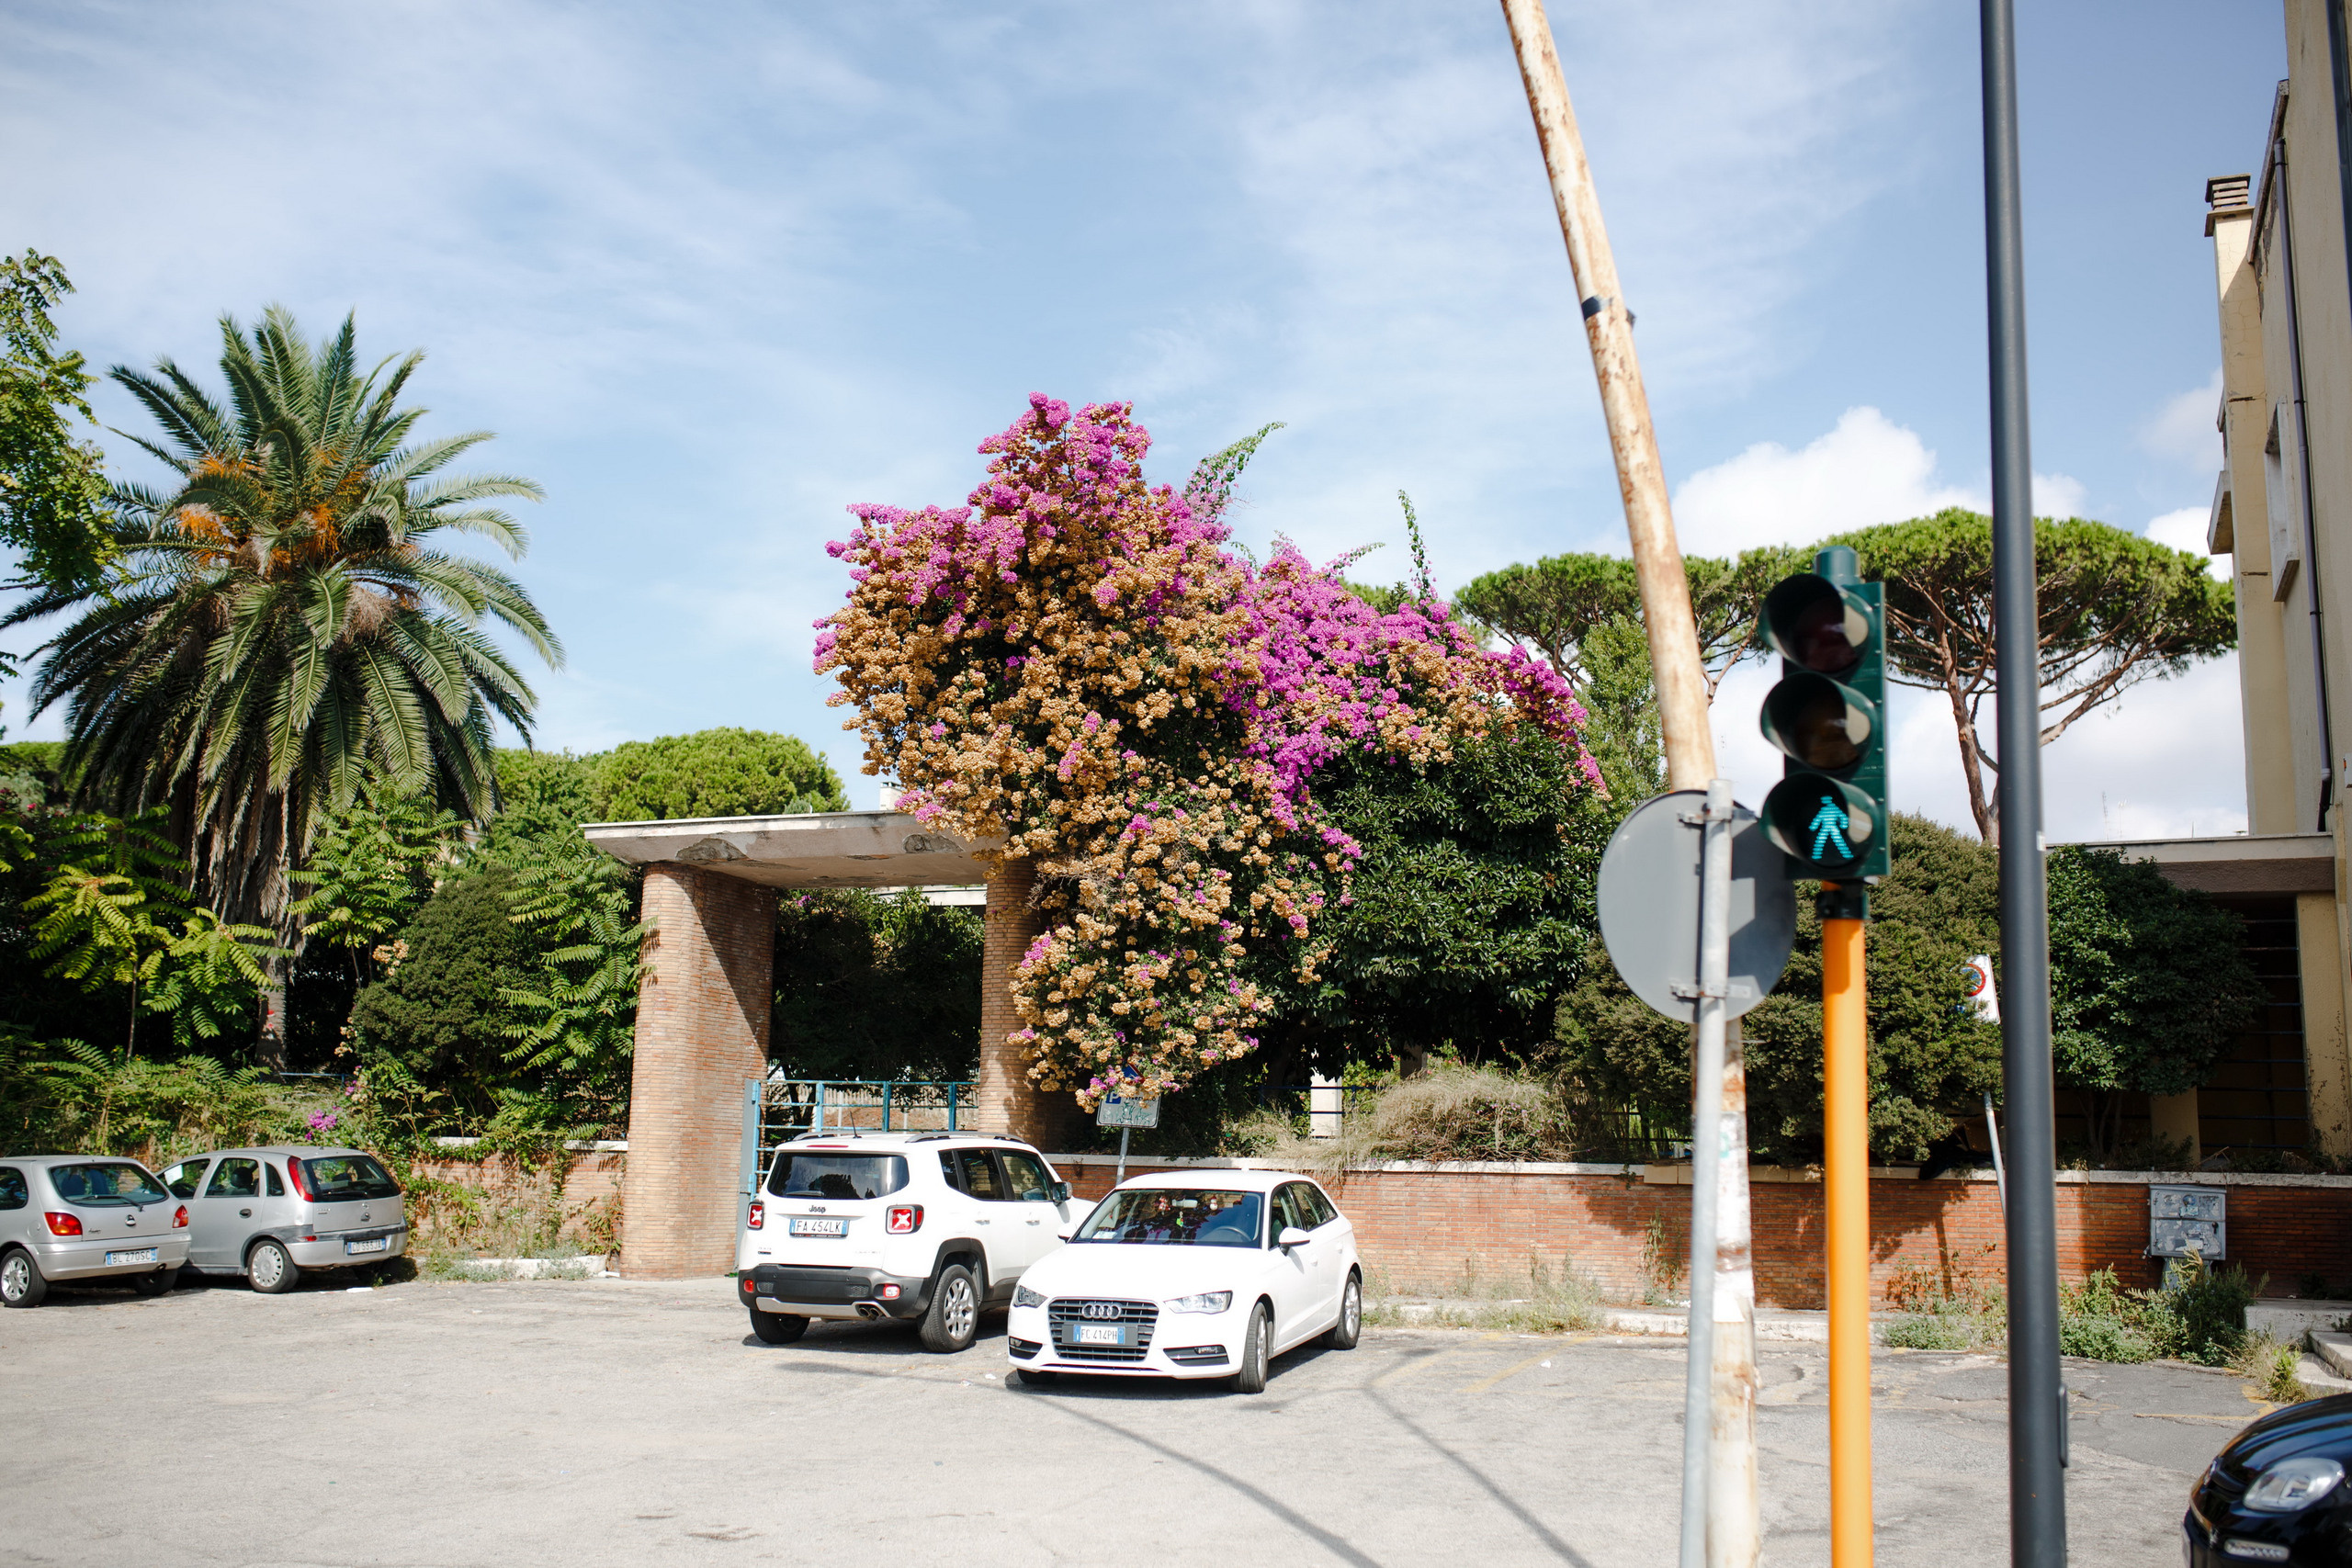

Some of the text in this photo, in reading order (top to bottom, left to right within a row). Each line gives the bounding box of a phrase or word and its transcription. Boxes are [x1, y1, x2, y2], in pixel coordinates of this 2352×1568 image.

[796, 1220, 842, 1233] FA 454LK
[112, 1251, 151, 1263] BL 270SC
[1080, 1328, 1117, 1341] FC 414PH
